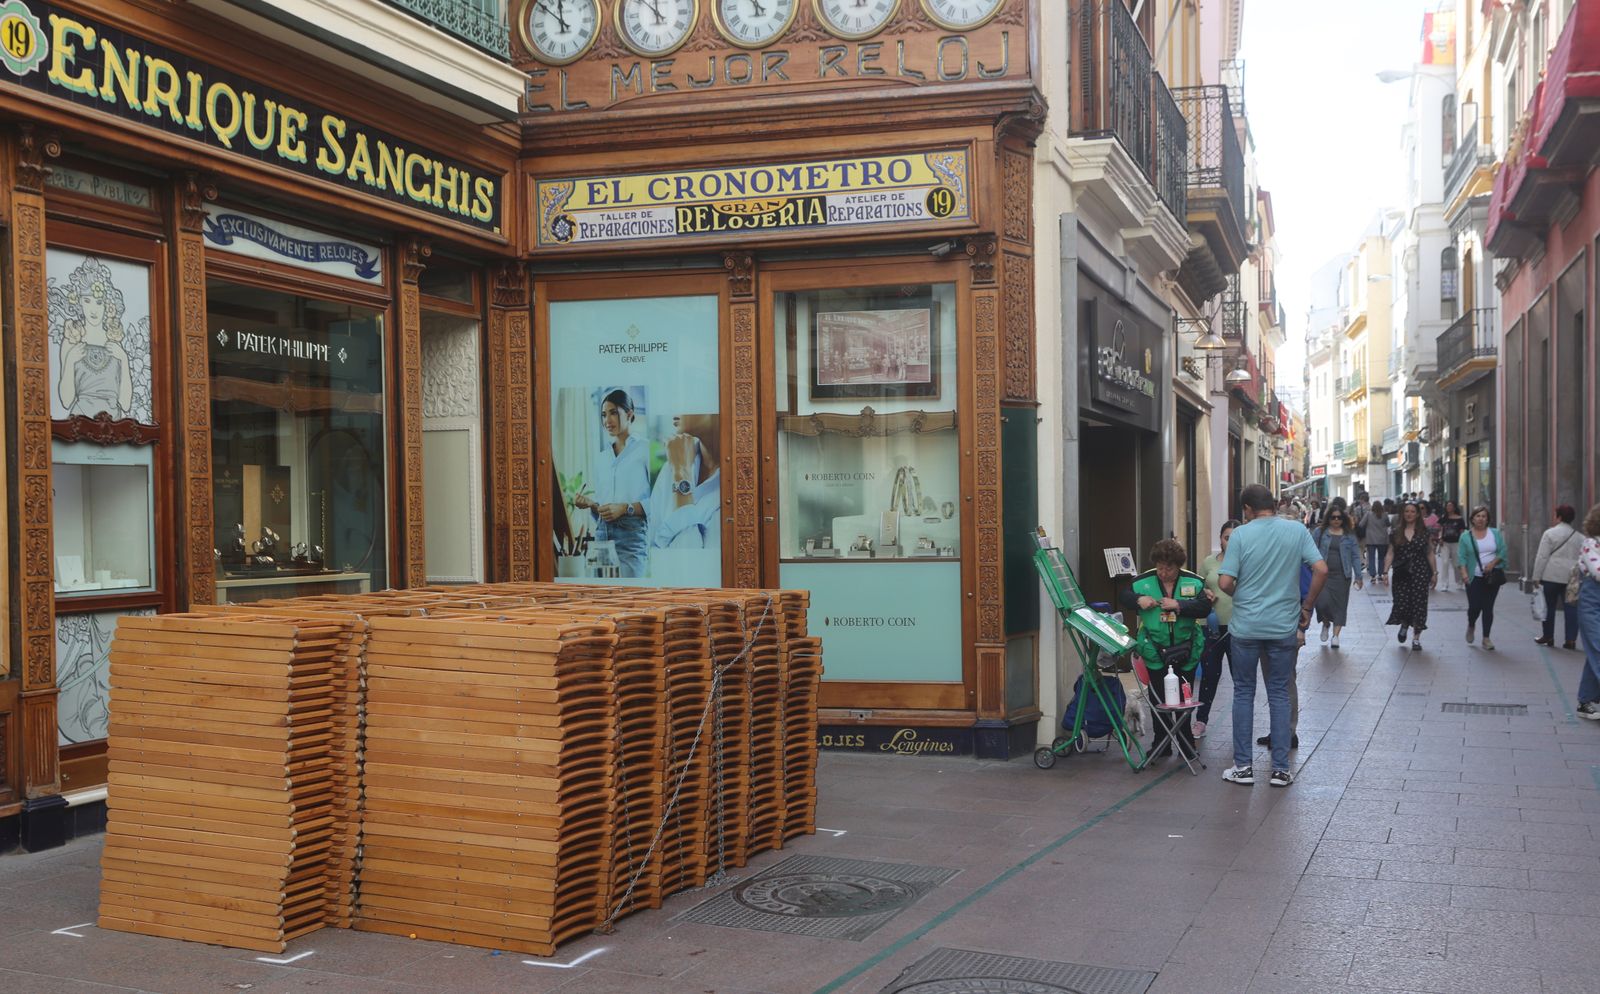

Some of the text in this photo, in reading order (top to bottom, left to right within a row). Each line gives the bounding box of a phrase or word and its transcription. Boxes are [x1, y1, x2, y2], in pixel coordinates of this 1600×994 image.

[8, 20, 30, 58] 19
[524, 30, 1010, 112] EL MEJOR RELOJ
[48, 13, 495, 223] ENRIQUE SANCHIS
[587, 158, 912, 206] EL CRONOMETRO
[719, 200, 780, 213] GRAN
[845, 193, 905, 204] ATELIER DE
[932, 189, 951, 215] 19
[600, 210, 653, 221] TALLER DE
[677, 197, 826, 234] RELOJERIA
[828, 202, 923, 223] REPARATIONS
[220, 218, 365, 265] EXCLUSIVAMENTE RELOJES
[579, 219, 675, 240] REPARACIONES
[236, 331, 332, 362] PATEK PHILIPPE
[599, 342, 669, 354] PATEK PHILIPPE
[811, 471, 875, 481] ROBERTO COIN
[833, 617, 916, 627] ROBERTO COIN
[879, 728, 954, 756] Longines
